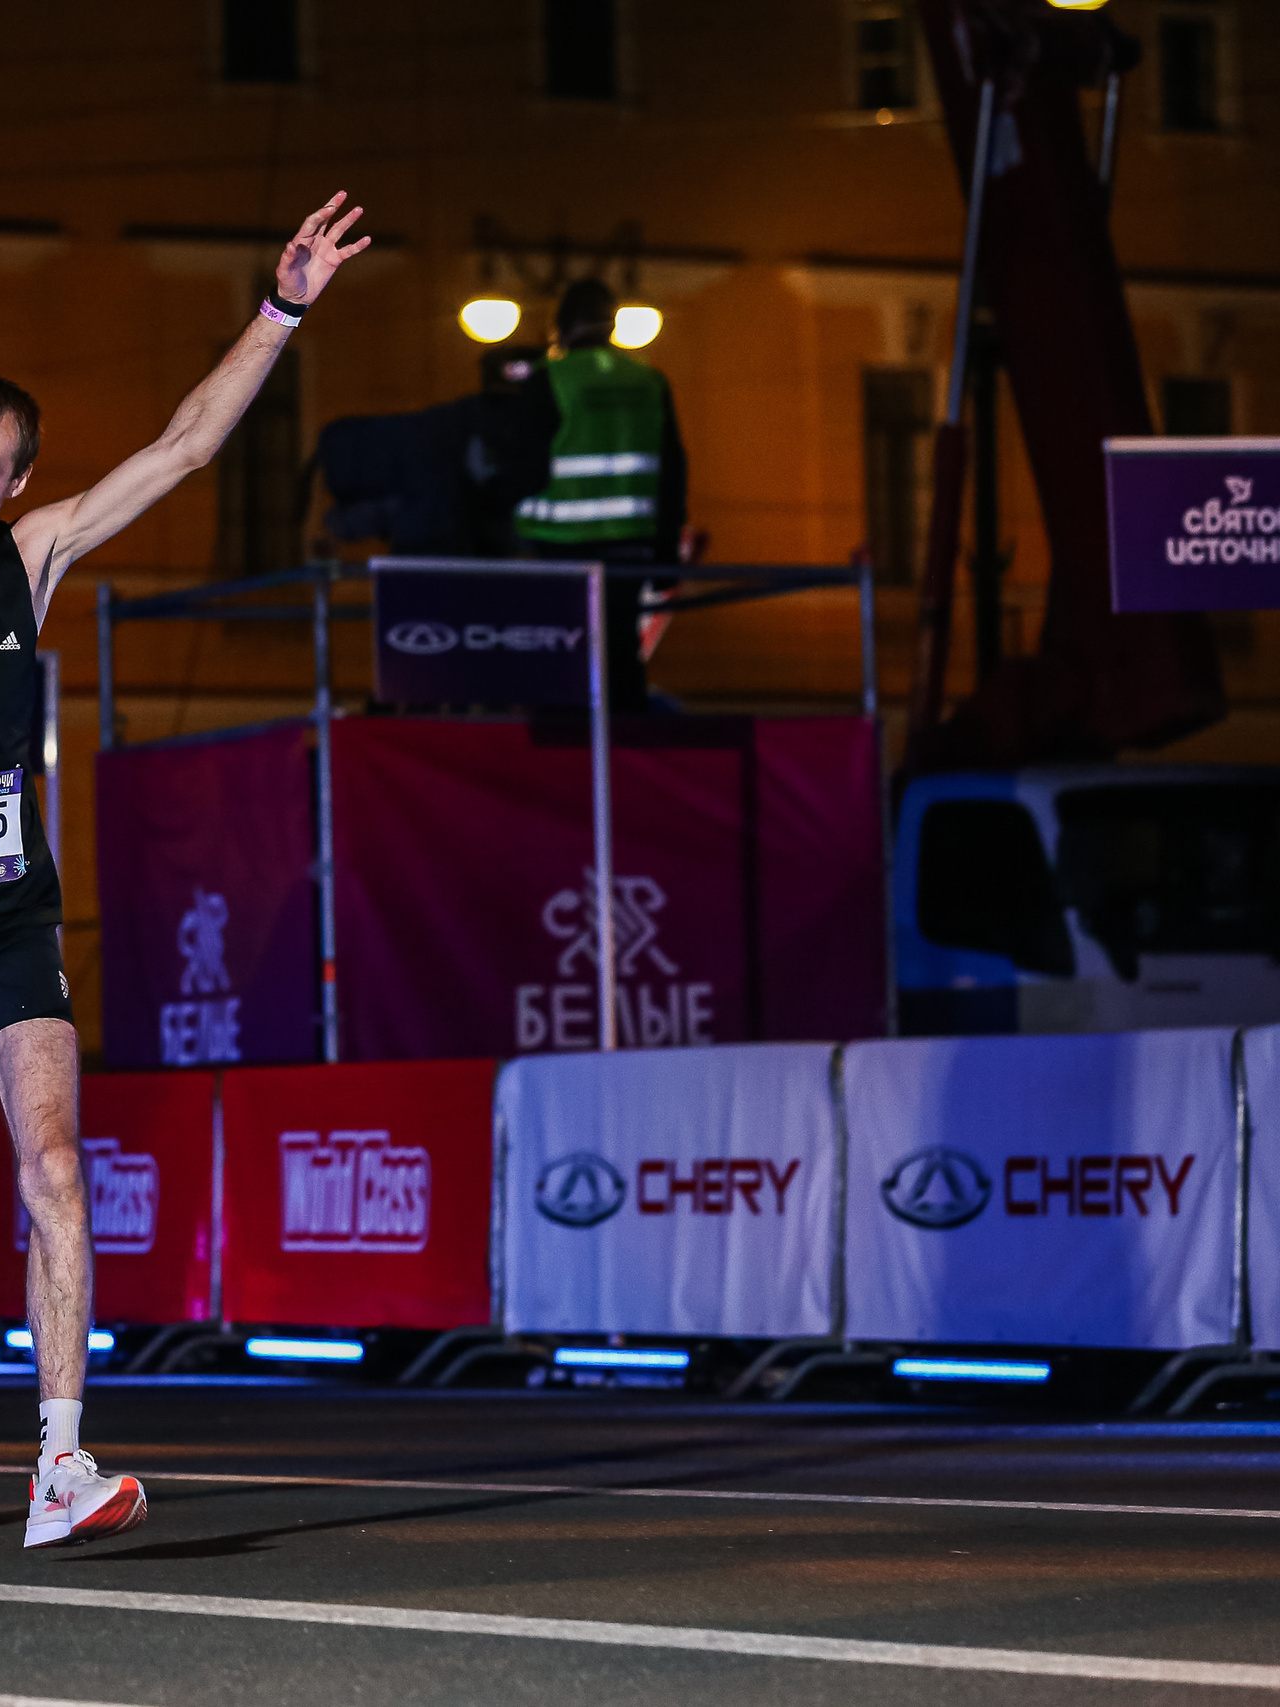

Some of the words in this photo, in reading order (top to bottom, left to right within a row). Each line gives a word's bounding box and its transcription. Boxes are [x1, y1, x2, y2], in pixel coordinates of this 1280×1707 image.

[463, 623, 584, 652] CHERY
[637, 1158, 801, 1216] CHERY
[1004, 1154, 1196, 1217] CHERY
